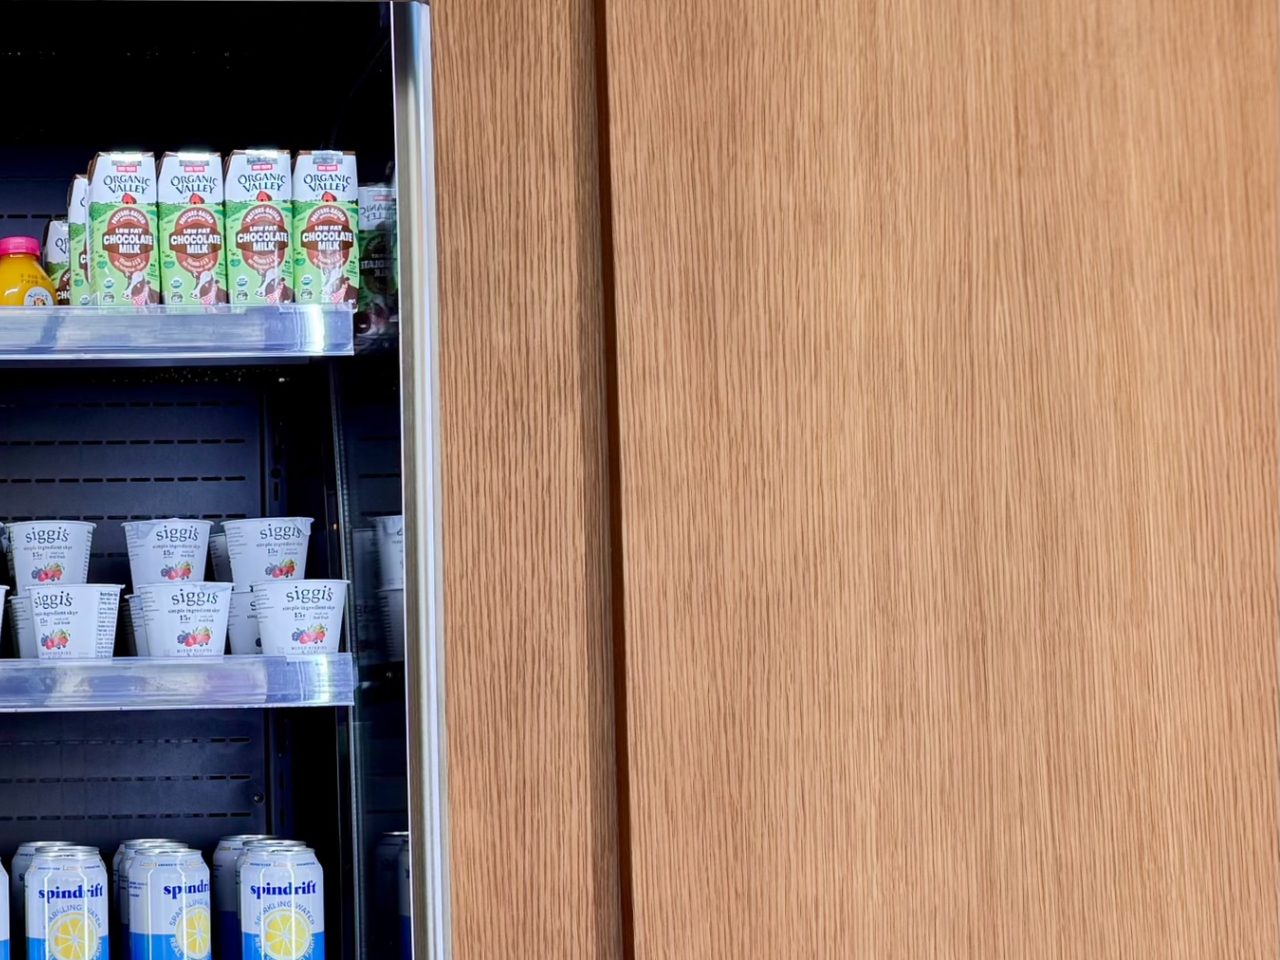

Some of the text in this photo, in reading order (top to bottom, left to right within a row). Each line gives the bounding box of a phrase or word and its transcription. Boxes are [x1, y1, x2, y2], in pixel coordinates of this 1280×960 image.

[103, 174, 151, 187] ORGANIC
[170, 174, 218, 187] ORGANIC
[237, 173, 286, 185] ORGANIC
[303, 173, 352, 185] ORGANIC
[108, 184, 147, 194] VALLEY
[175, 184, 215, 194] VALLEY
[242, 182, 283, 193] VALLEY
[308, 183, 348, 192] VALLEY
[103, 234, 153, 245] CHOCOLATE
[170, 235, 222, 245] CHOCOLATE
[237, 232, 288, 243] CHOCOLATE
[302, 232, 352, 242] CHOCOLATE
[119, 244, 141, 254] MILK
[187, 244, 209, 254] MILK
[253, 242, 275, 251] MILK
[318, 241, 340, 250] MILK
[25, 526, 69, 544] siggi's
[156, 525, 199, 542] siggi's
[286, 585, 333, 604] siggi's
[250, 880, 317, 900] spindrift
[295, 902, 315, 925] WATER
